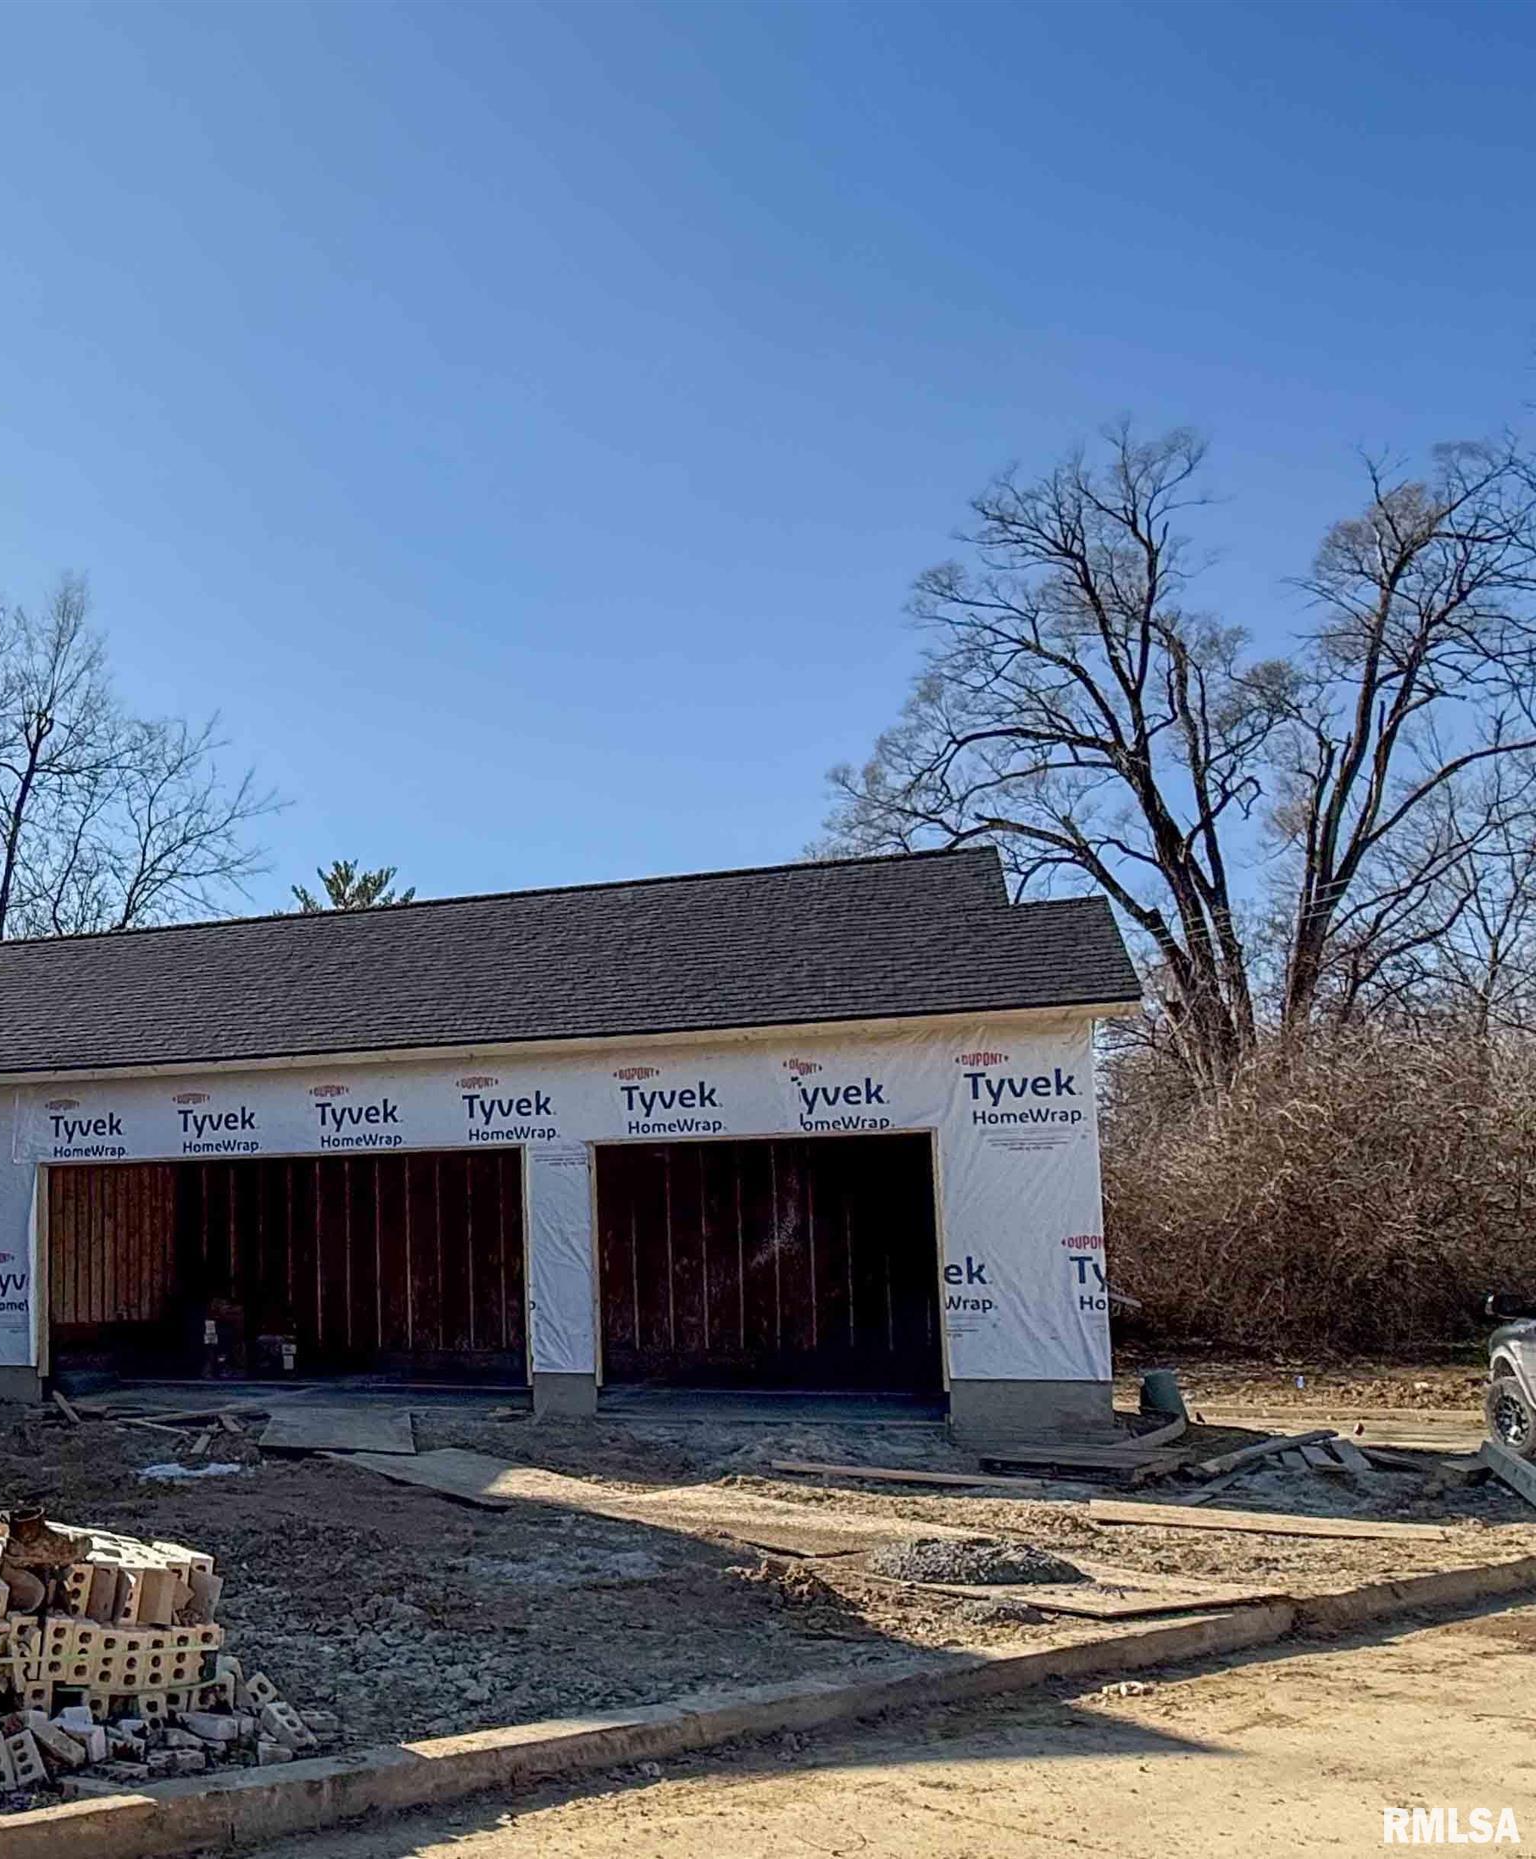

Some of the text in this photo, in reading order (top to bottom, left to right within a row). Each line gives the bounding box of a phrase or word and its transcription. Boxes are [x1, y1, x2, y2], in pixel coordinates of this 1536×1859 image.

[961, 1053, 1003, 1066] DUPONT
[618, 1067, 655, 1080] DUPONT
[461, 1077, 494, 1089] DUPONT
[964, 1068, 1076, 1106] Tyvek
[462, 1090, 552, 1125] Tyvek
[620, 1081, 717, 1118] Tyvek
[178, 1106, 255, 1138] Tyvek
[315, 1099, 398, 1130] Tyvek
[973, 1108, 1082, 1125] HomeWrap
[50, 1112, 122, 1143] Tyvek
[468, 1126, 556, 1141] HomeWrap
[628, 1118, 722, 1135] HomeWrap
[183, 1139, 258, 1153] HomeWrap
[321, 1132, 402, 1147] HomeWrap
[54, 1145, 126, 1158] HomeWrap
